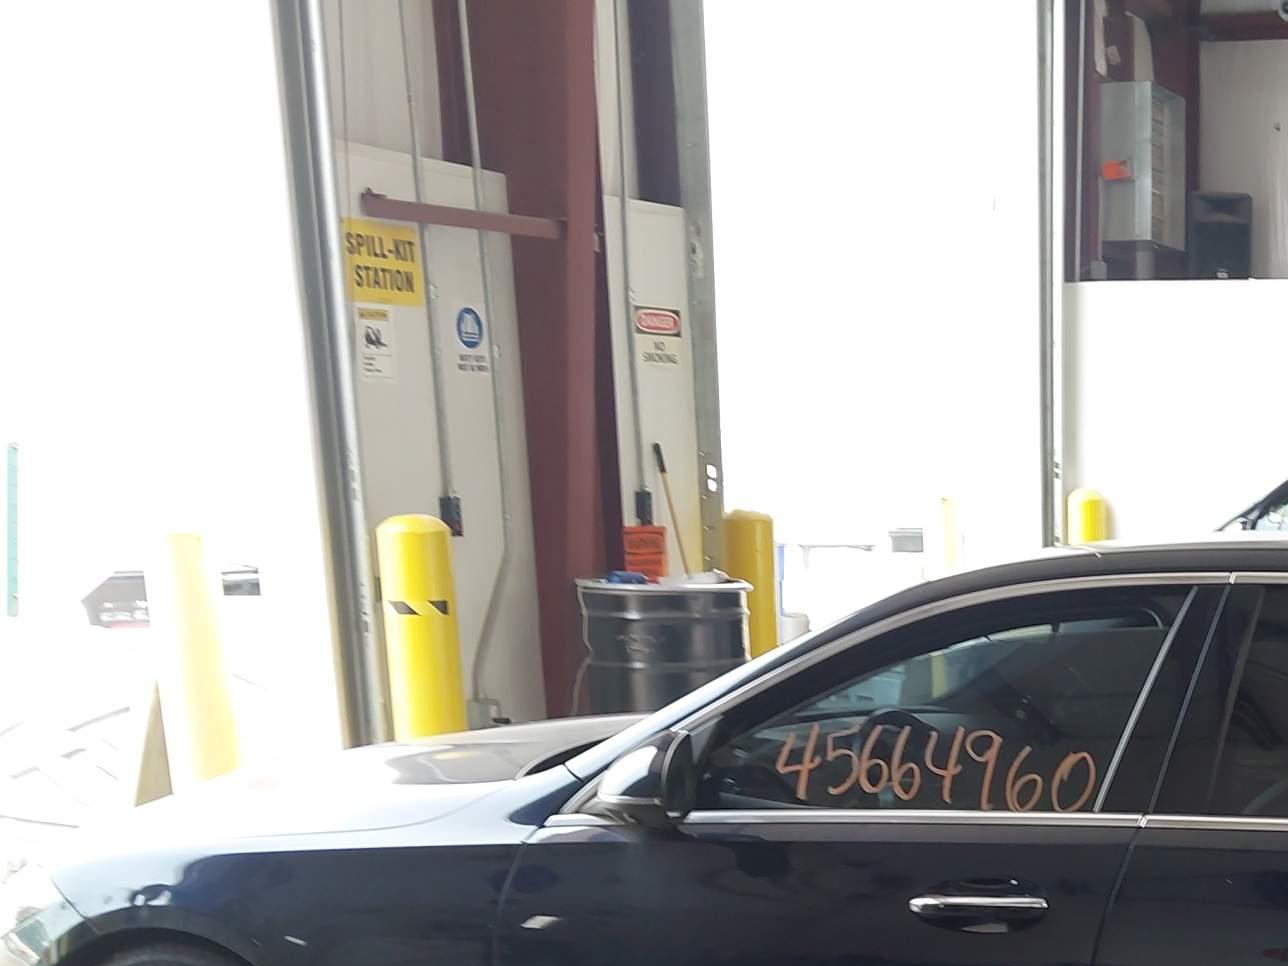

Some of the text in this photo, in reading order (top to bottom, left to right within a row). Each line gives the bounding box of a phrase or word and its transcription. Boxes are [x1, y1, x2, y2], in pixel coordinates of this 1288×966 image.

[345, 231, 416, 263] SPILL-KIT
[354, 264, 415, 293] STATION
[775, 722, 1097, 812] 45664960
